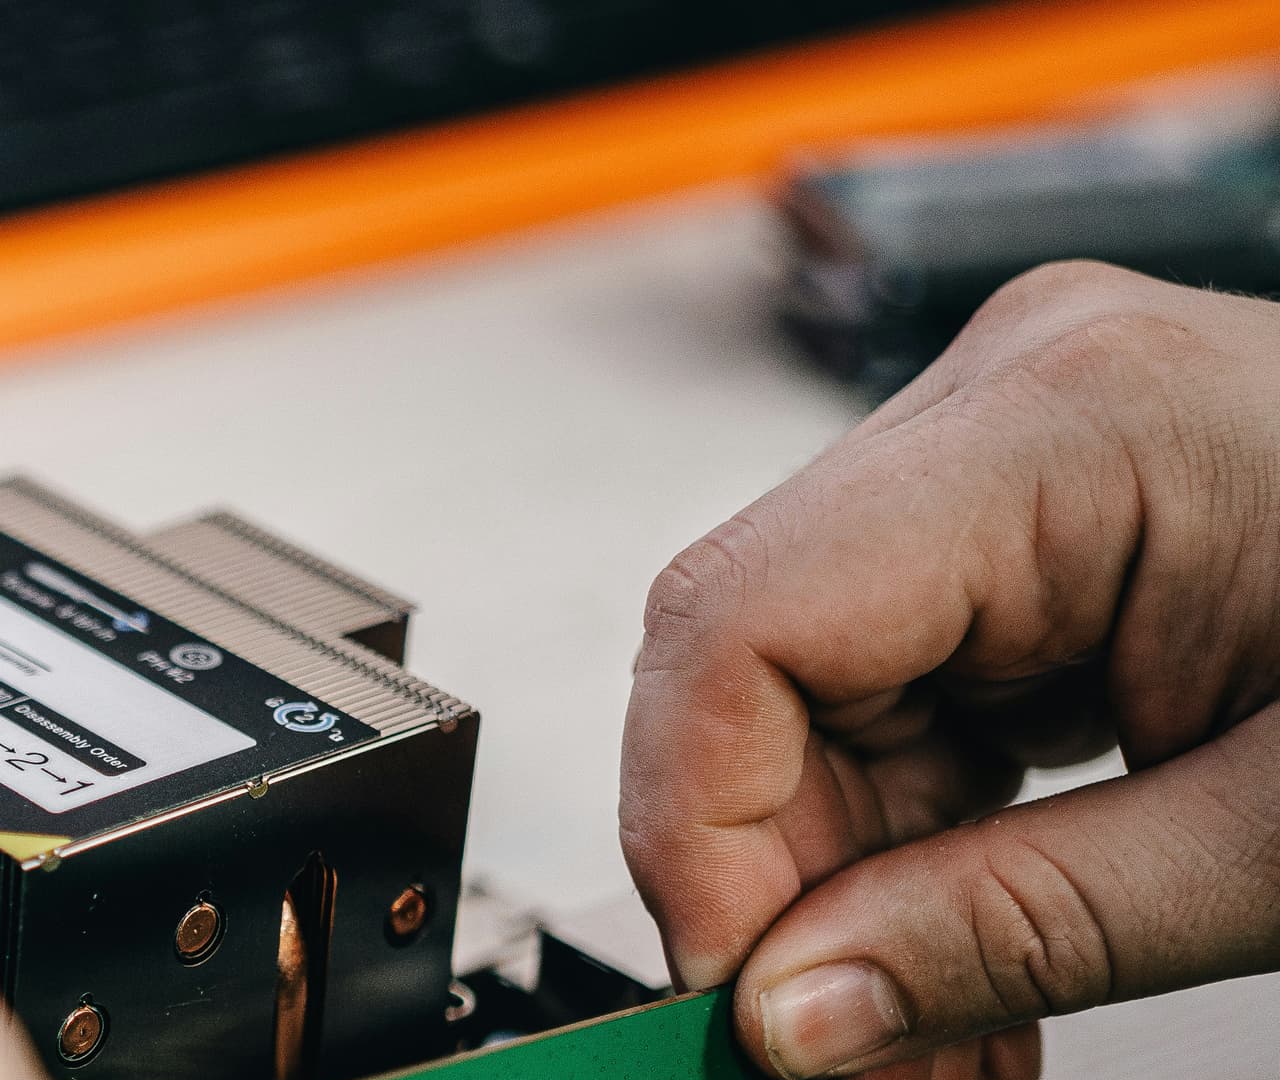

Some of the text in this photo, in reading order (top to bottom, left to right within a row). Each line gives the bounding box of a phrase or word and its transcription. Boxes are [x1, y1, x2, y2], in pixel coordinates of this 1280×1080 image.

[14, 704, 129, 771] Disassembly Order
[4, 752, 49, 772] 2
[59, 780, 96, 796] 1
